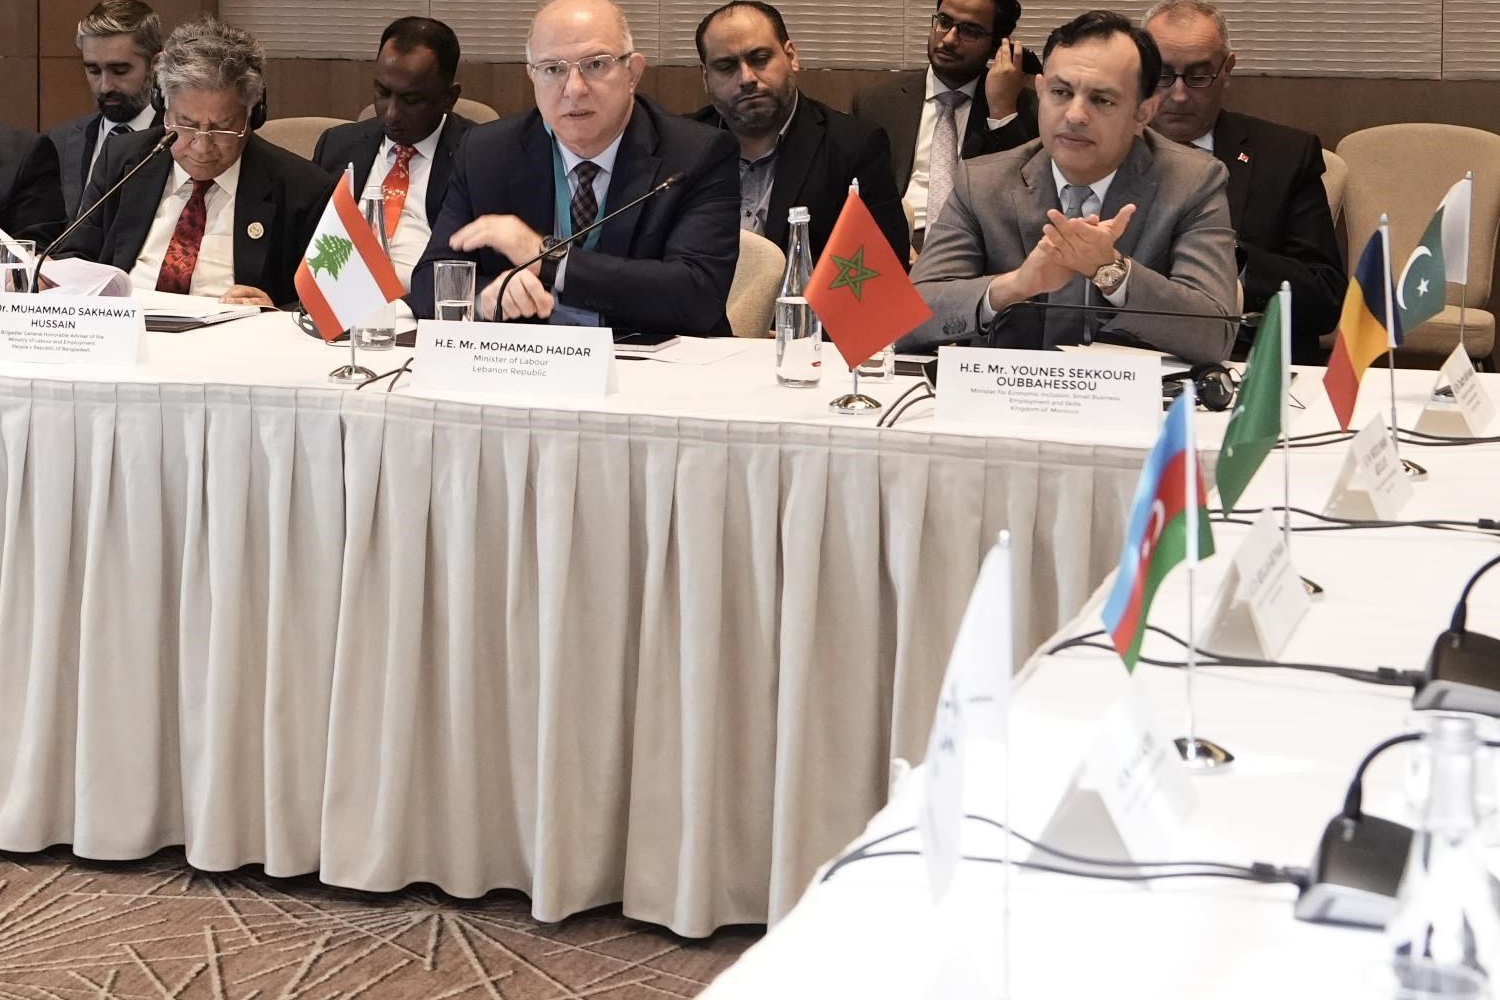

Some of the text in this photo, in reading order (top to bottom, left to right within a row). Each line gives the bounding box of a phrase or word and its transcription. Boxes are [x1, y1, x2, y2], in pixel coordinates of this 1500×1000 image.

[11, 305, 76, 316] MUHAMMAD
[78, 307, 137, 319] SAKHAWAT
[31, 319, 76, 329] HUSSAIN
[435, 339, 591, 357] H.E. Mr. MOHAMAD HAIDAR
[473, 354, 548, 366] Minister of Labour
[472, 365, 547, 377] Lebanon Republic
[960, 363, 1136, 381] H.E. Mr. YOUNES SEKKOURI
[996, 376, 1097, 391] OUBBAHESSOU
